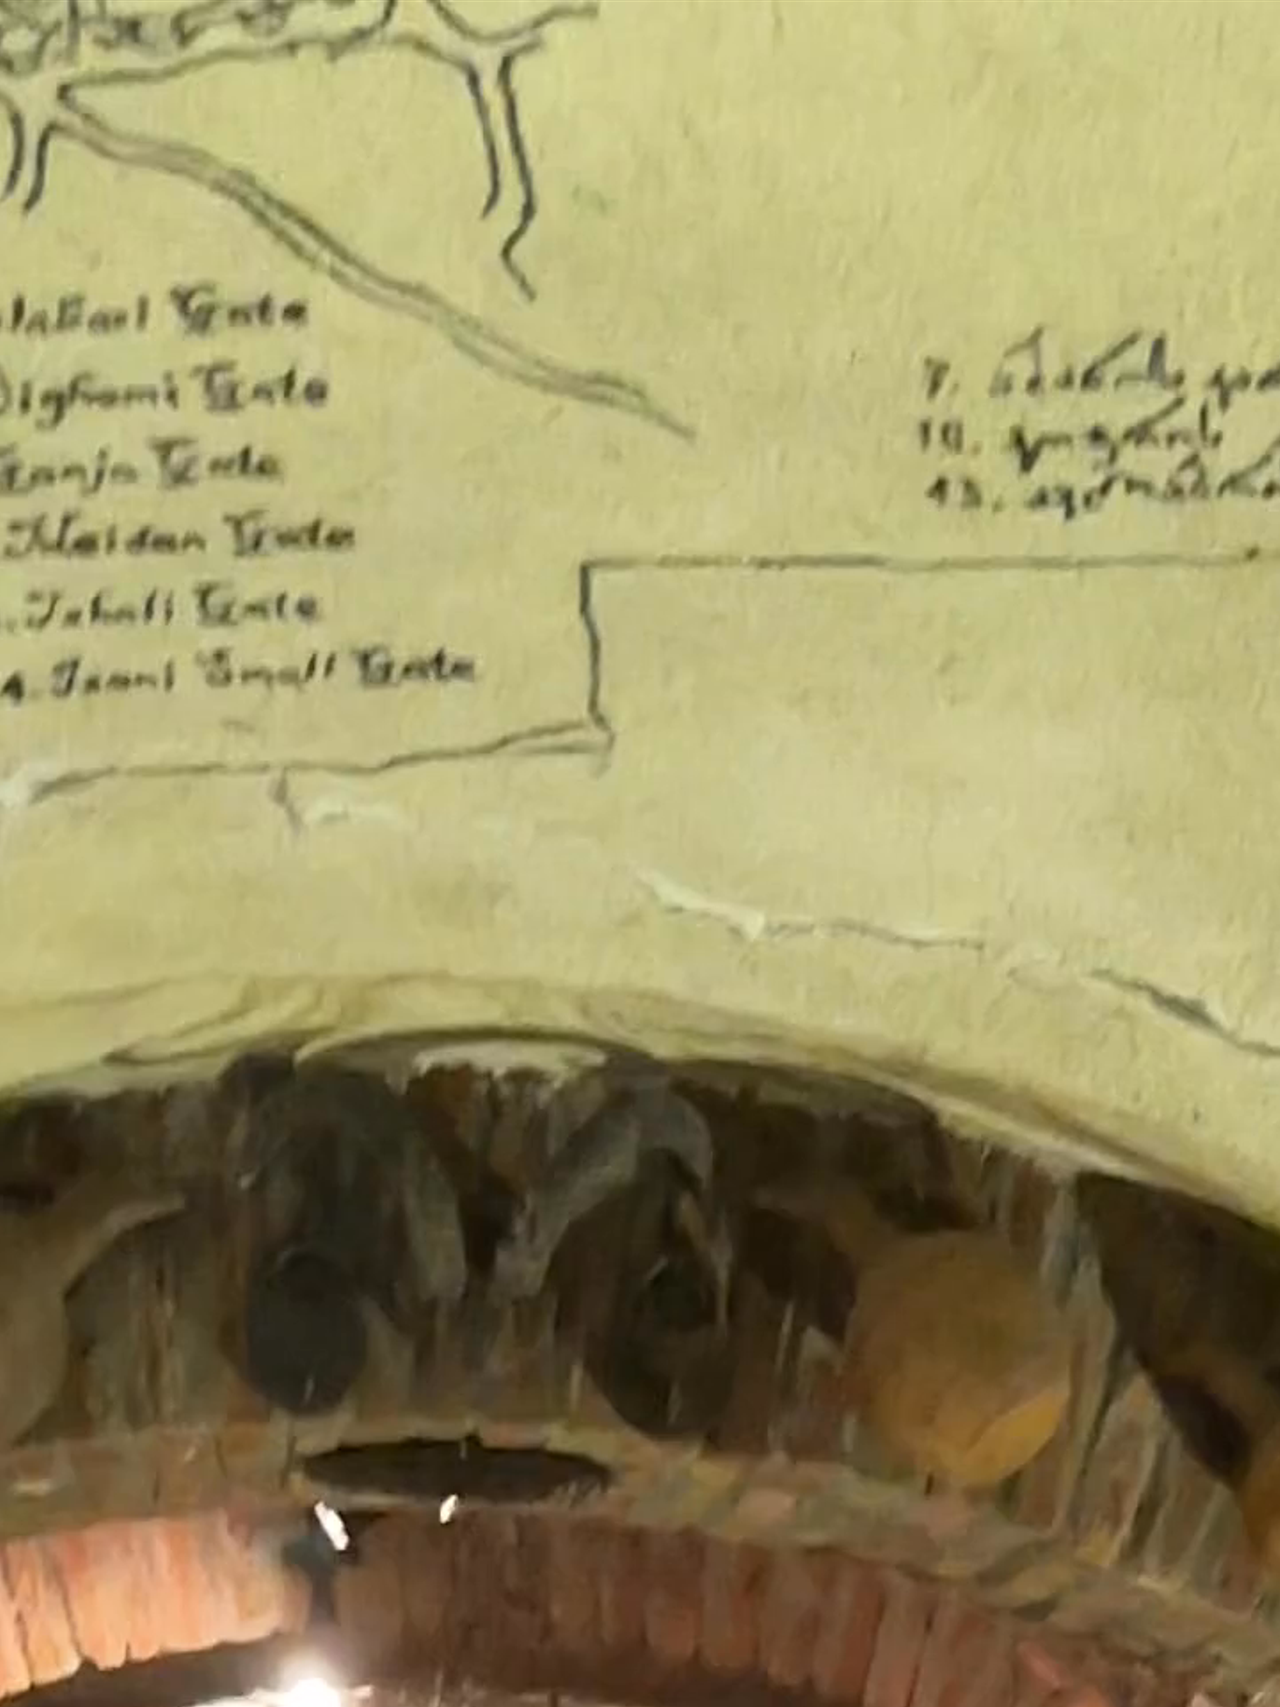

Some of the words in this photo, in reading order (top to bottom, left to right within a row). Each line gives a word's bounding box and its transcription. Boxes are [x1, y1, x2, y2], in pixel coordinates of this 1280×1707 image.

[169, 282, 309, 334] Gate
[190, 359, 329, 412] Gate
[148, 435, 283, 489] Gate
[223, 508, 355, 558] Gate
[193, 580, 319, 627] Gate
[195, 647, 336, 692] Small
[352, 644, 477, 688] Gate
